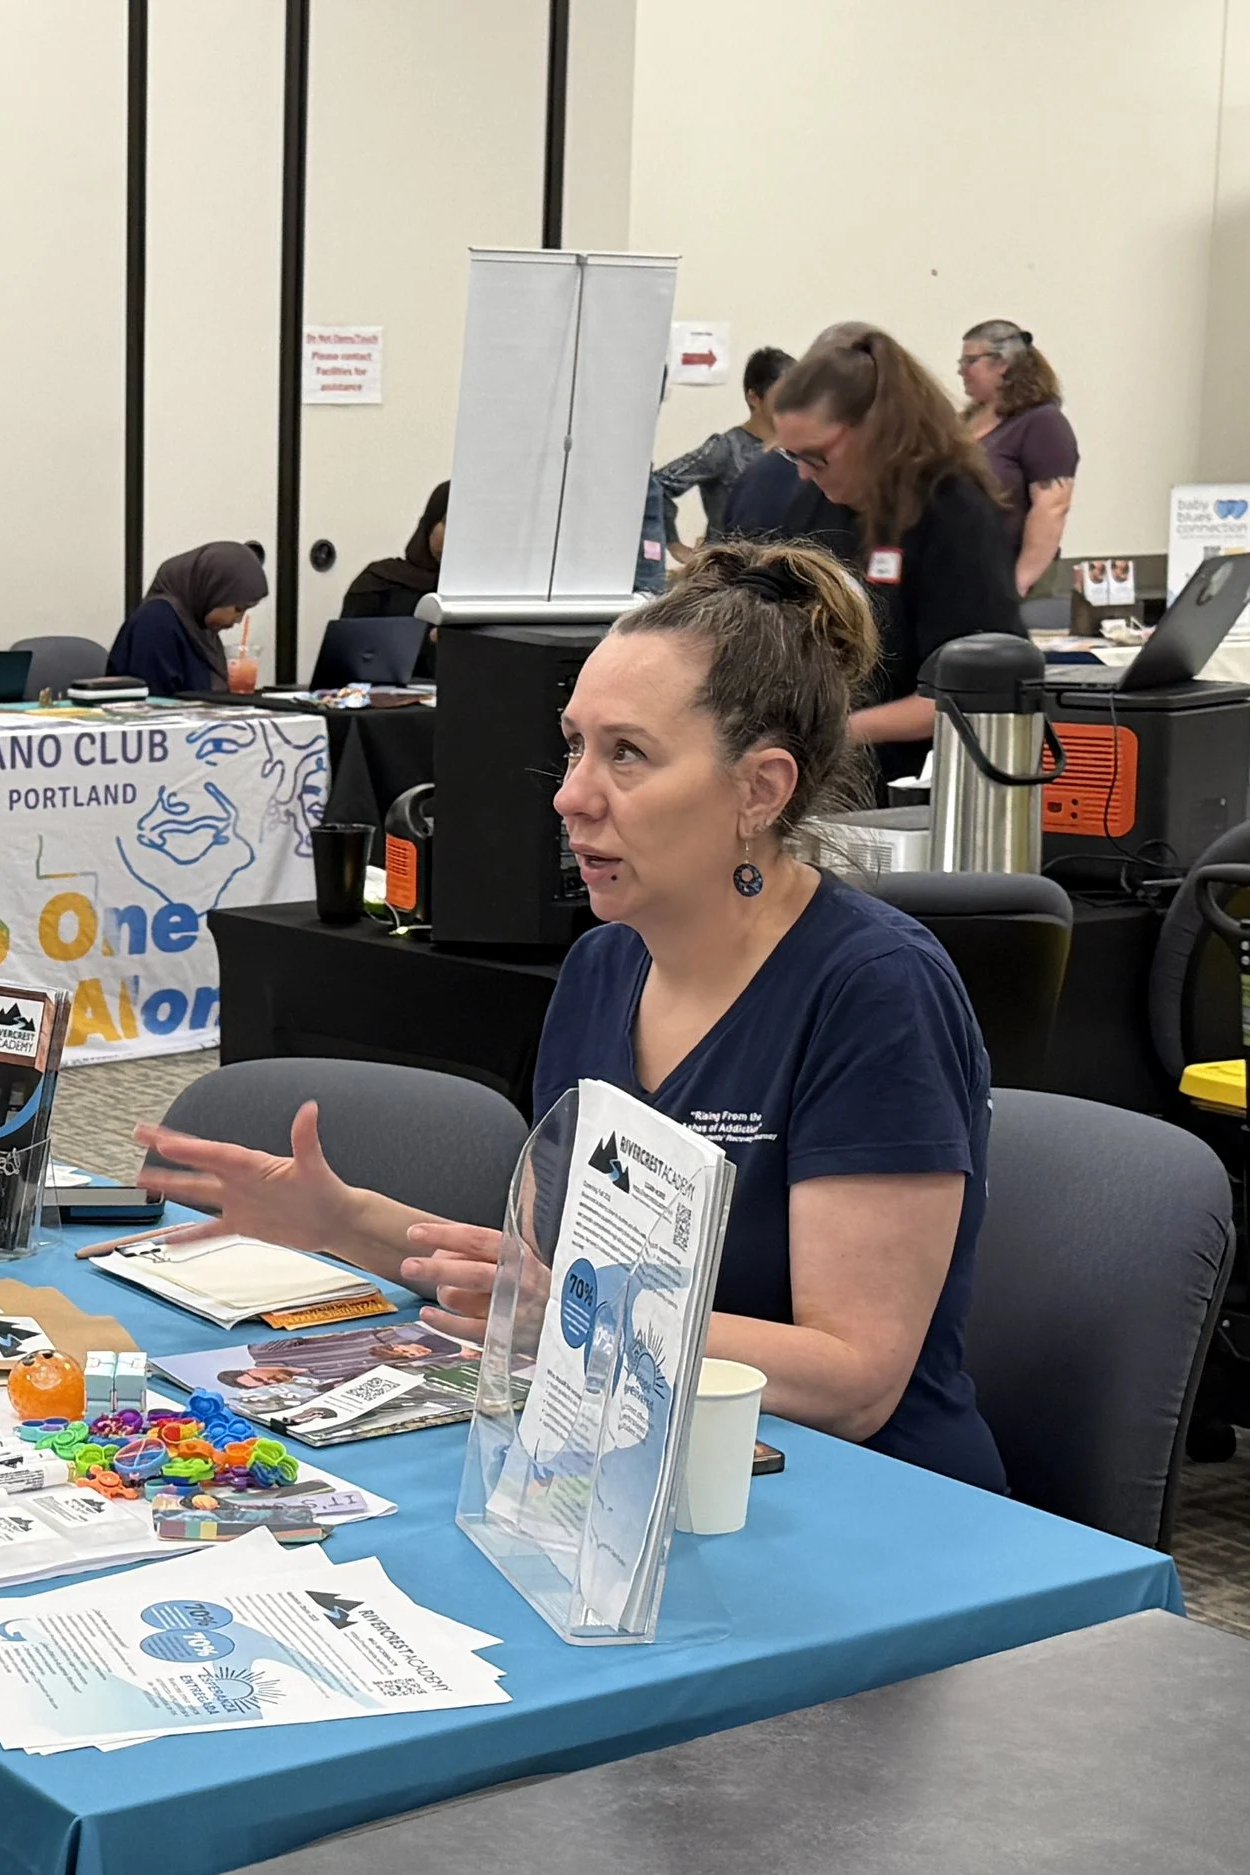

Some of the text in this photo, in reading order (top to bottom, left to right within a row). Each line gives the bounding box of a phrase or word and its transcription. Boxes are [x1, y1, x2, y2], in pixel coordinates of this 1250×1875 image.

[1176, 511, 1212, 522] blues
[1177, 499, 1209, 512] baby
[1176, 522, 1247, 534] connection
[74, 730, 170, 765] CLUB
[8, 783, 138, 811] PORTLAND
[38, 892, 199, 962] One
[64, 975, 221, 1047] Alon
[709, 1123, 717, 1132] of
[722, 1111, 748, 1121] From
[750, 1112, 762, 1121] the
[619, 1135, 664, 1179] RIVERCREST
[569, 1275, 594, 1308] 70%
[184, 1603, 218, 1628] 70%
[190, 1632, 218, 1657] 70%
[358, 1609, 411, 1654] RIVERCREST
[401, 1650, 453, 1693] ACADEMY
